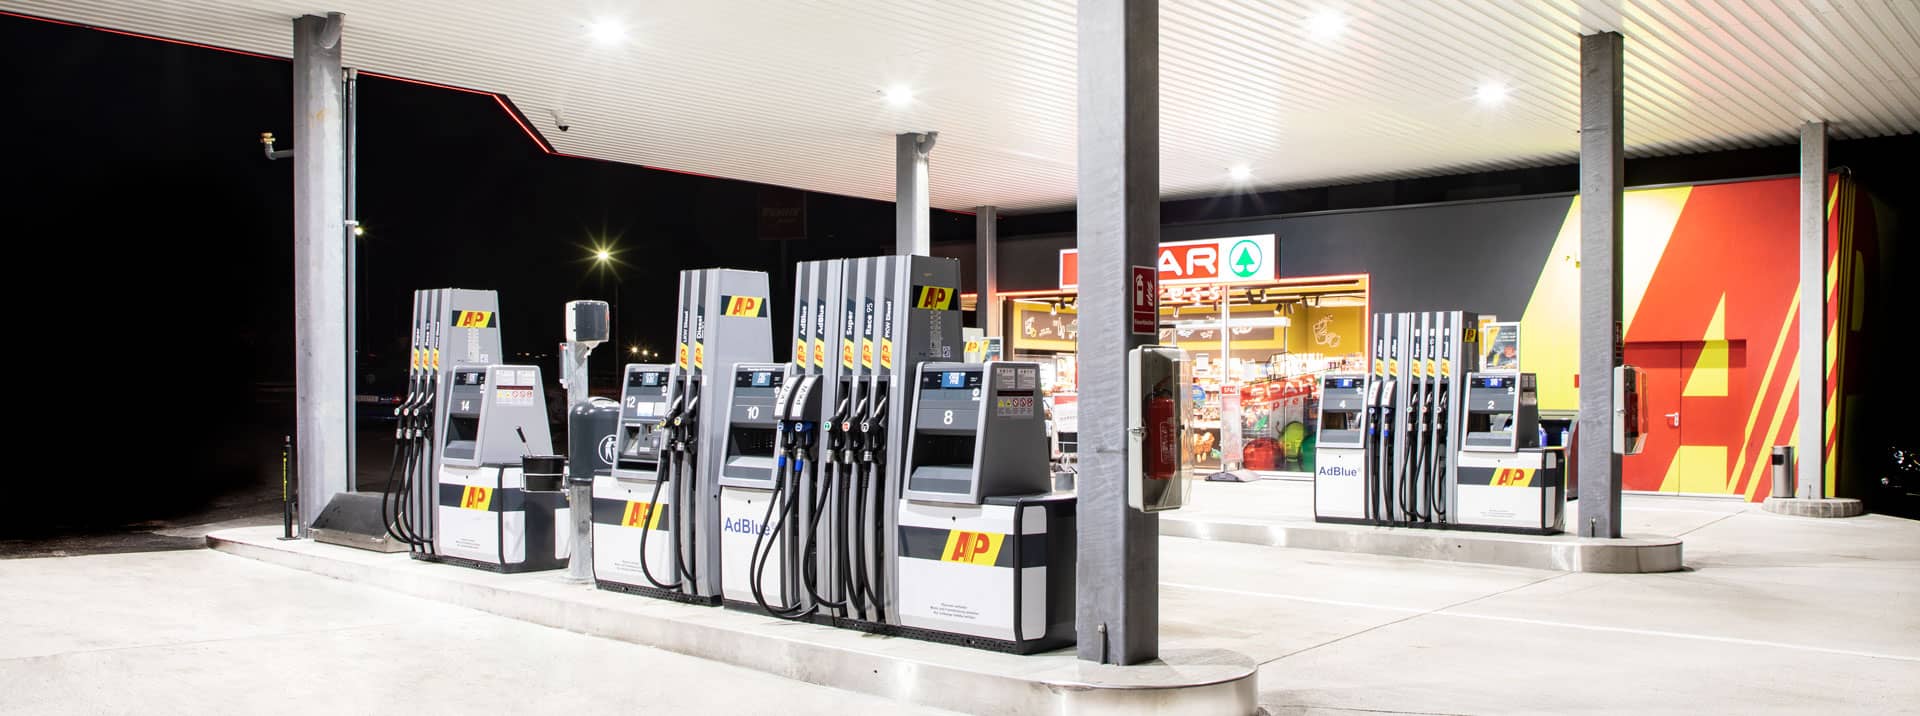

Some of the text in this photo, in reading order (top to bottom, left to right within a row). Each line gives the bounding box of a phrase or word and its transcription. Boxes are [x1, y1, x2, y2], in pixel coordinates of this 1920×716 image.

[922, 287, 946, 309] AP
[732, 297, 755, 316] AP
[867, 302, 873, 312] 95
[463, 311, 485, 327] AP
[461, 400, 470, 411] 14
[626, 396, 636, 408] 12
[1339, 400, 1346, 409] 4
[1487, 400, 1495, 410] 2
[747, 406, 759, 420] 10
[943, 410, 953, 425] 8
[1497, 468, 1525, 486] AP
[466, 486, 486, 508] AP
[951, 531, 990, 562] AP
